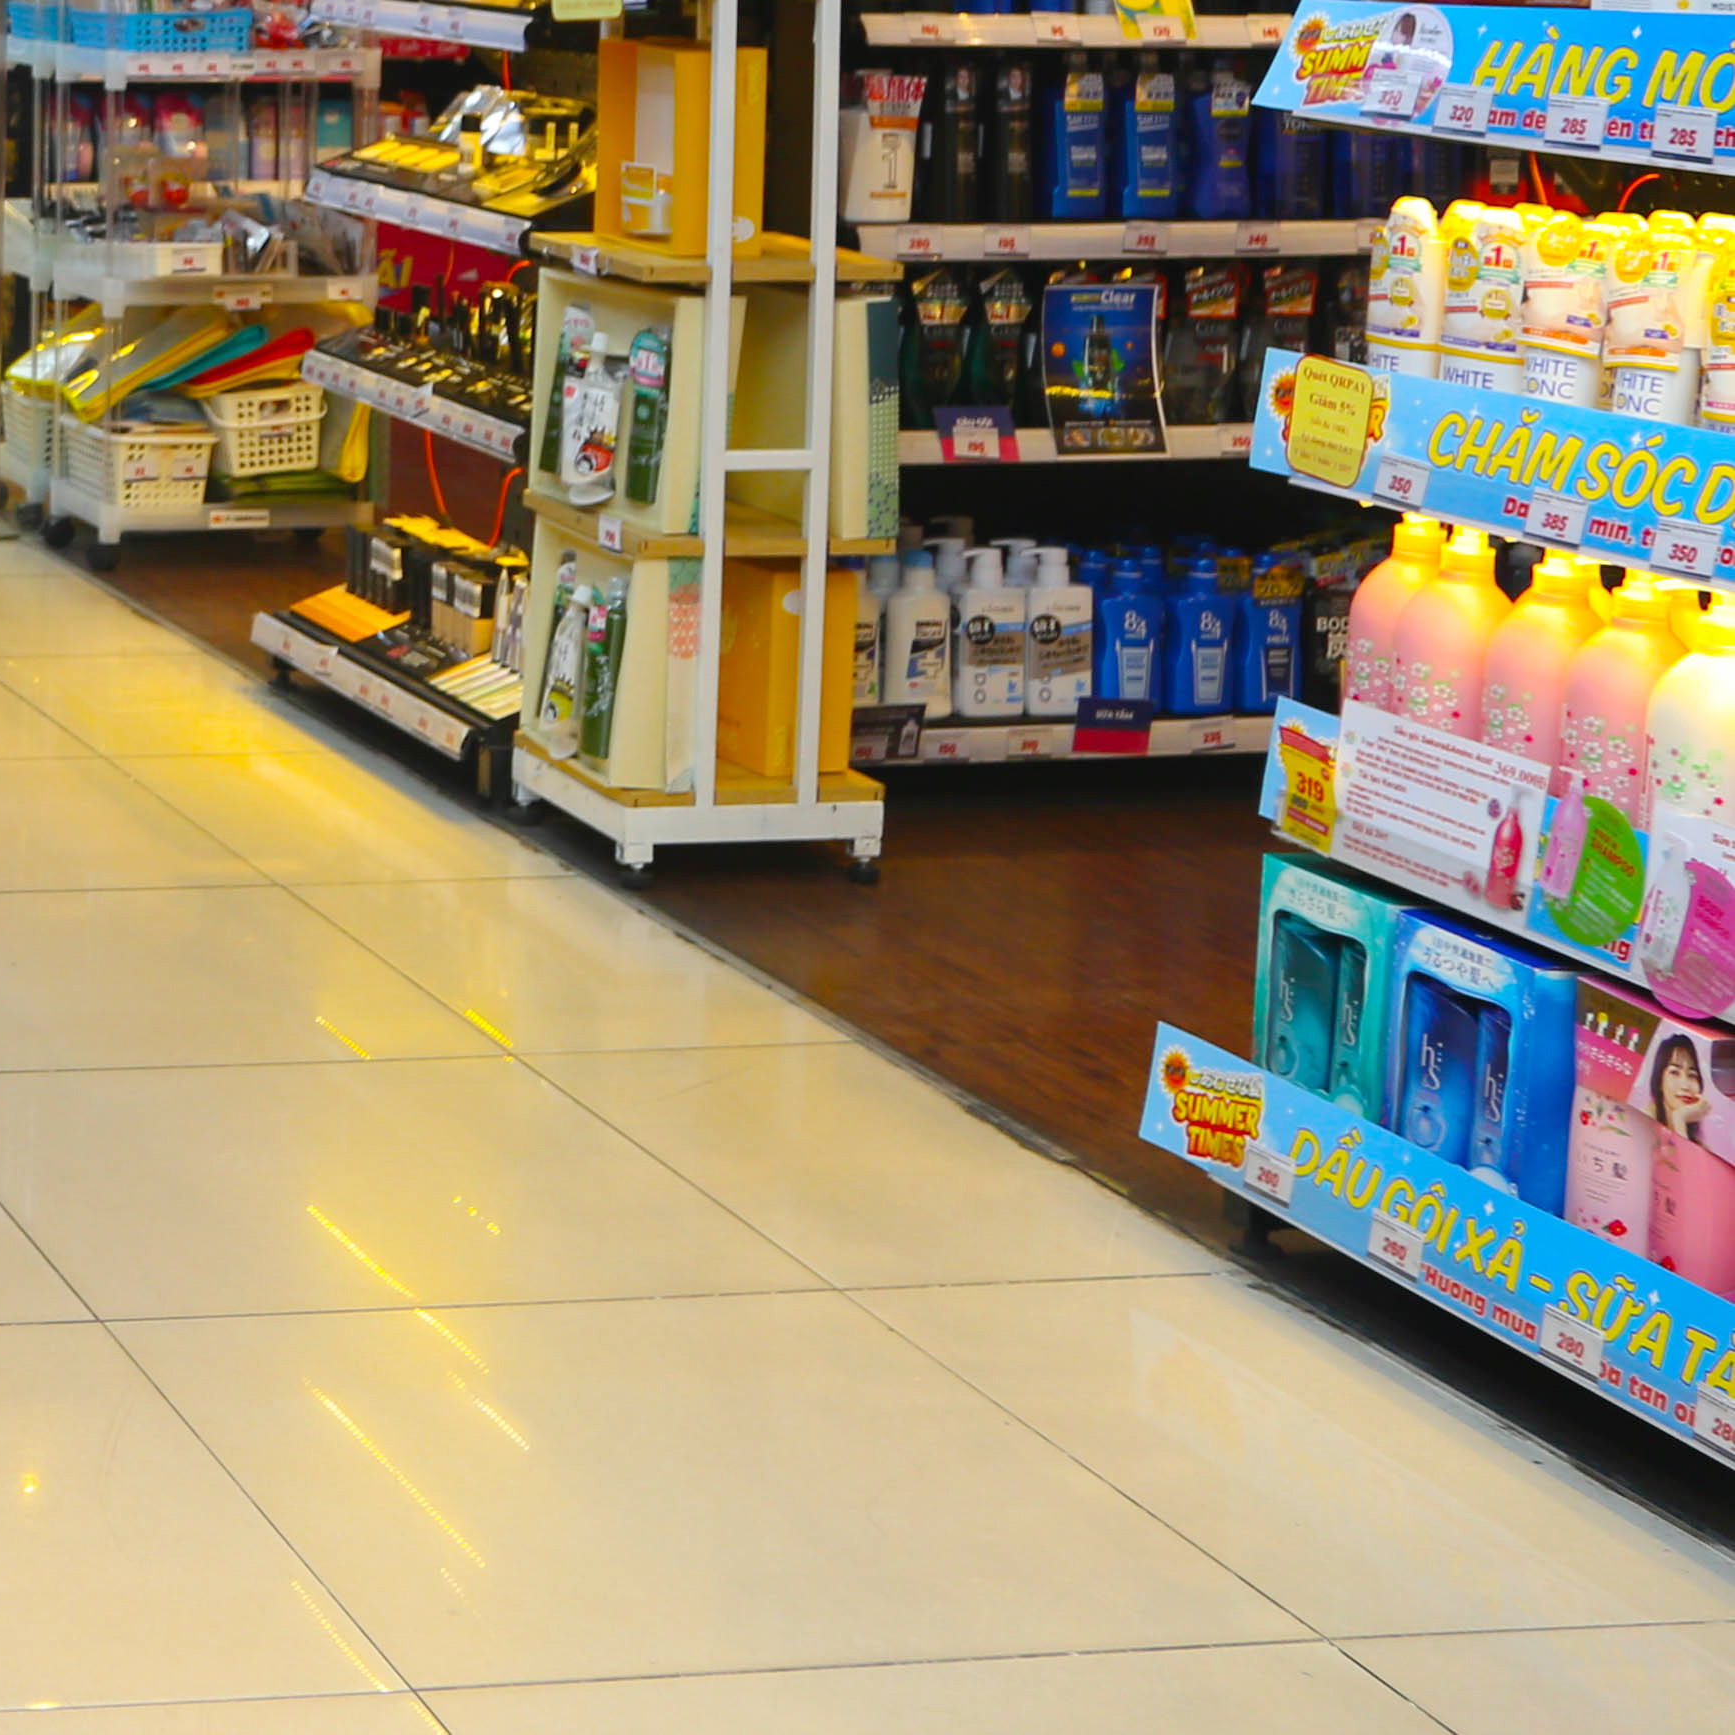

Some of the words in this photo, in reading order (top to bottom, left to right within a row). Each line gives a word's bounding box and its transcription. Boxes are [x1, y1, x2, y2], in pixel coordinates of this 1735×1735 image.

[1473, 25, 1639, 106] HÀNG
[1449, 105, 1474, 123] 320
[1560, 117, 1587, 136] 285
[1442, 366, 1494, 390] WHITE
[1428, 408, 1581, 492] CHĂM
[1576, 434, 1699, 517] SÓC
[1540, 513, 1569, 533] 385
[1668, 542, 1698, 565] 350
[1296, 771, 1326, 802] 319
[1256, 1166, 1280, 1188] 260
[1556, 1332, 1584, 1359] 280
